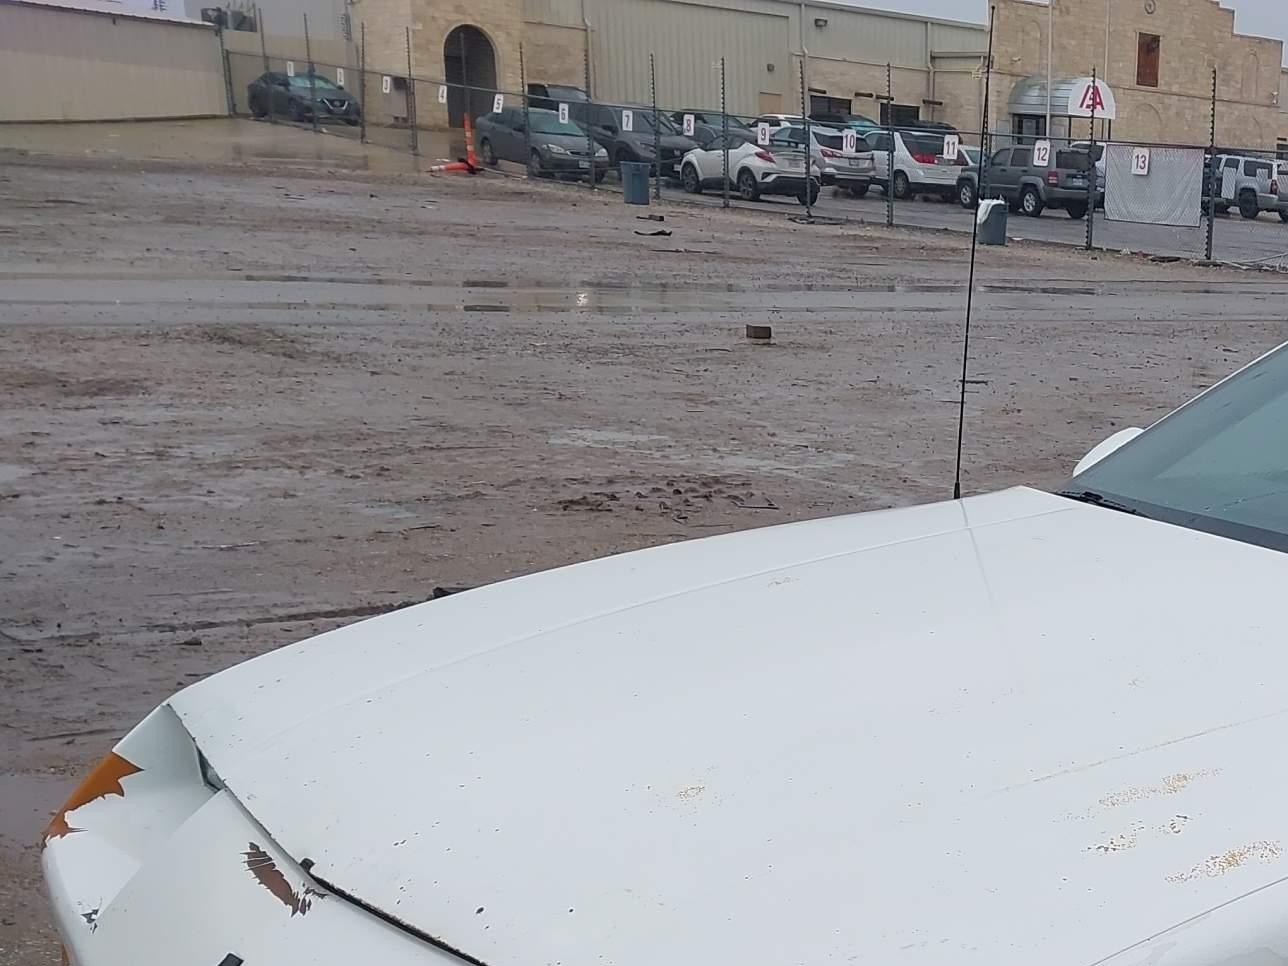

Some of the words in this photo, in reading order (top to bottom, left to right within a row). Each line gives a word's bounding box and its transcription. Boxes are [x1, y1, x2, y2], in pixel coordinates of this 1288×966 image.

[495, 98, 501, 110] 5
[561, 108, 566, 121] 6
[624, 114, 630, 128] 7
[686, 118, 692, 132] 8
[760, 128, 767, 140] 9
[844, 134, 855, 149] 10
[946, 141, 957, 155] 11
[1036, 147, 1048, 161] 12
[1135, 154, 1146, 169] 13
